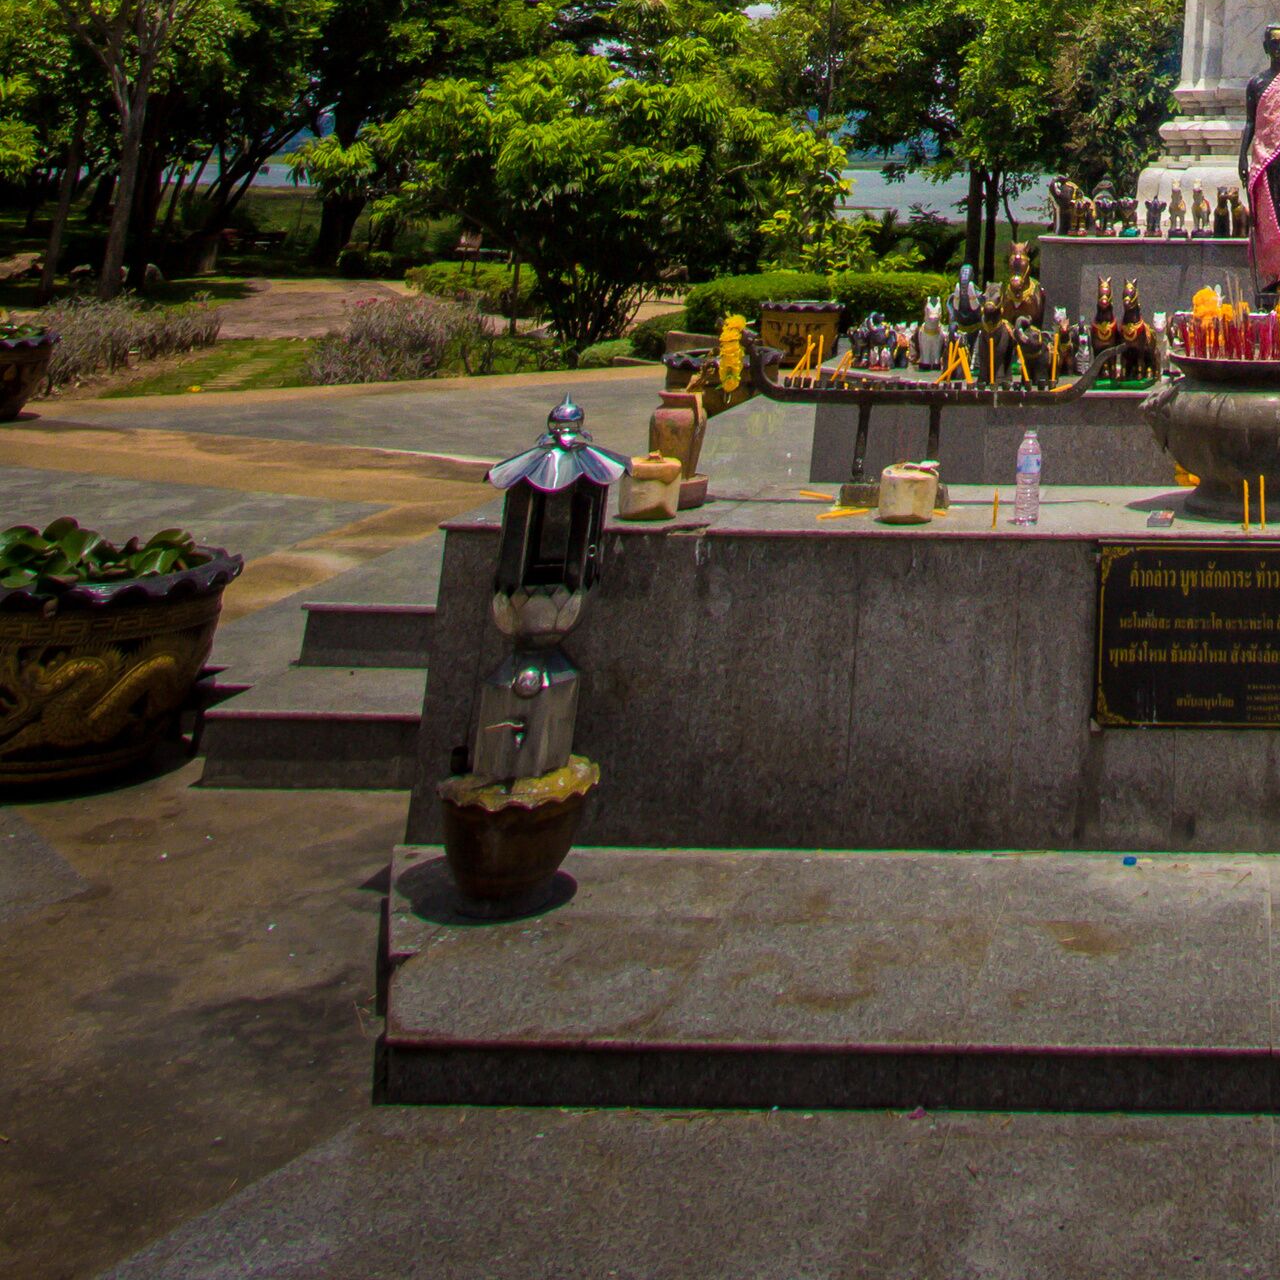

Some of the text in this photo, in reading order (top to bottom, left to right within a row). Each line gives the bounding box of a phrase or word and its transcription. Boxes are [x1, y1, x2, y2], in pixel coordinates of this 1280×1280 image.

[1129, 560, 1176, 588] คำกล่าว
[1180, 560, 1252, 597] บูชาสักการะ
